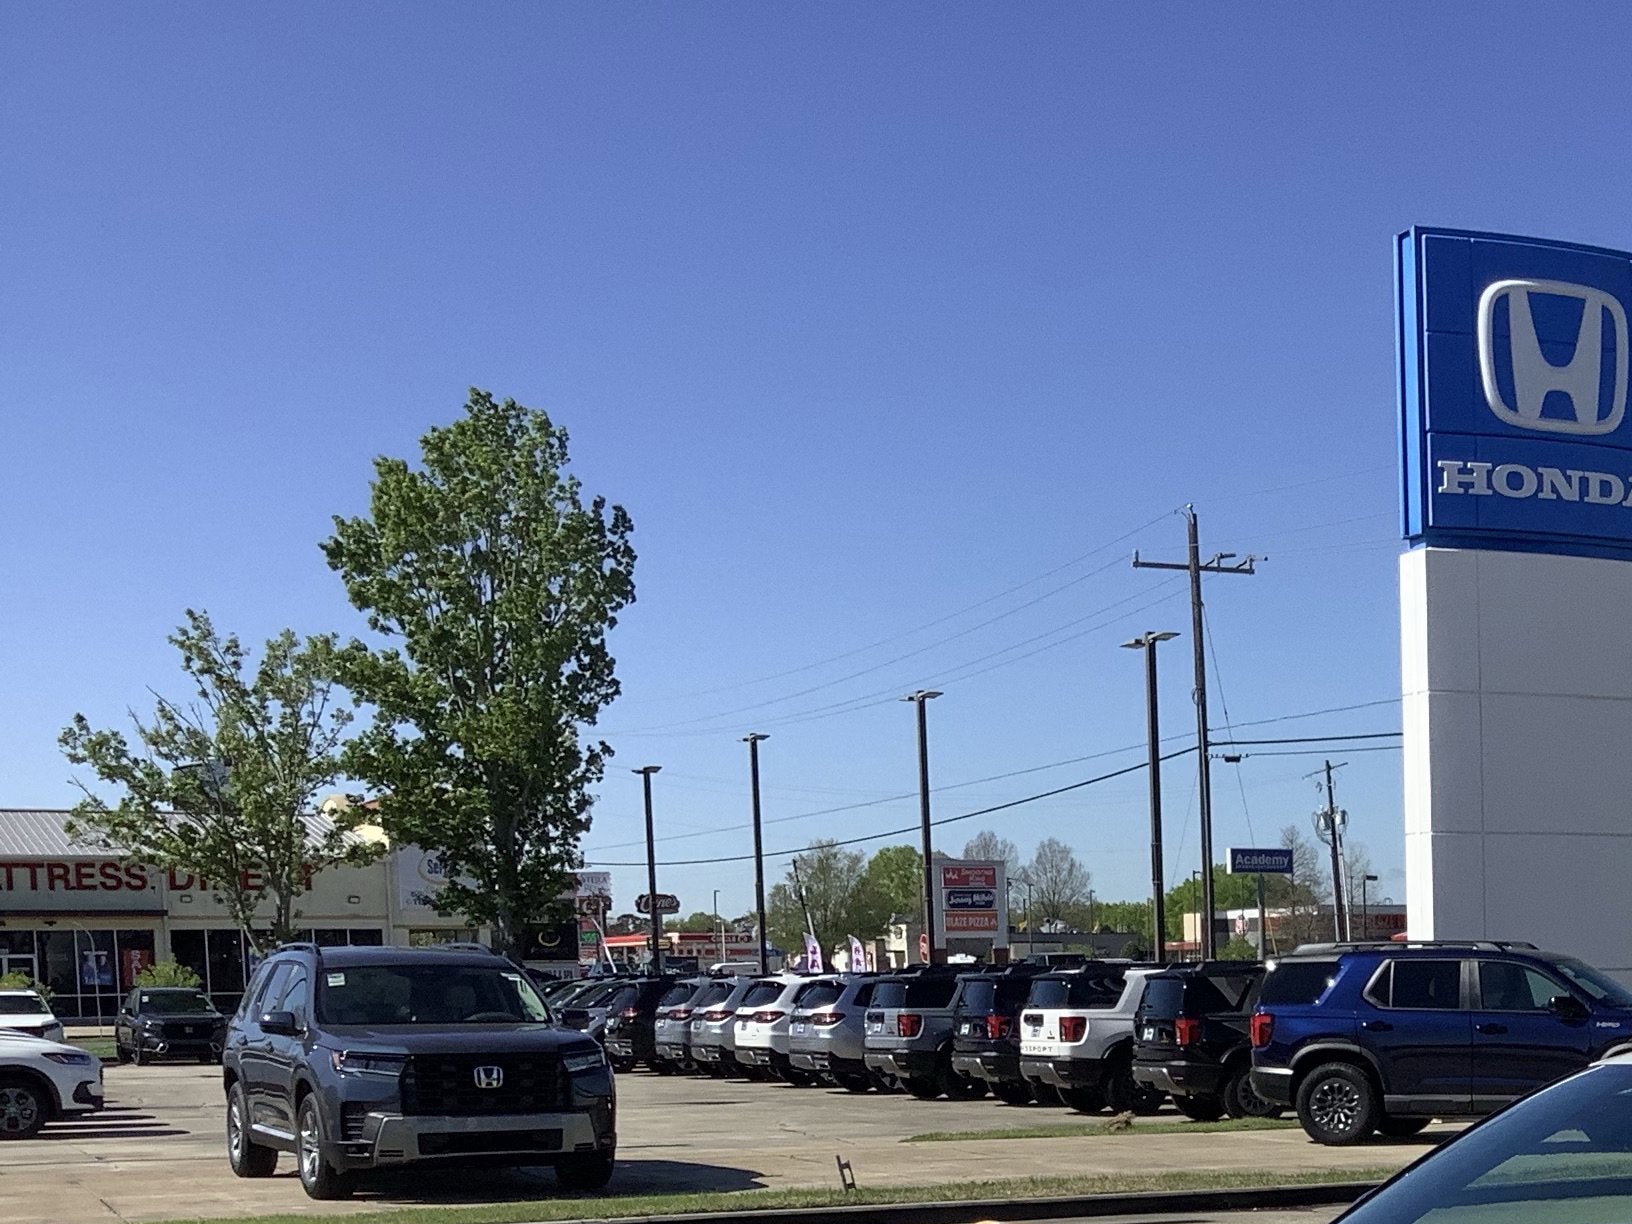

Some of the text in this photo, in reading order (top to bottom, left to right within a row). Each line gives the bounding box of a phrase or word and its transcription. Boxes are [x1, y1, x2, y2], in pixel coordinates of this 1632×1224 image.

[1236, 854, 1289, 867] Academy
[0, 862, 148, 891] TTRESS
[969, 917, 989, 927] PIZZA
